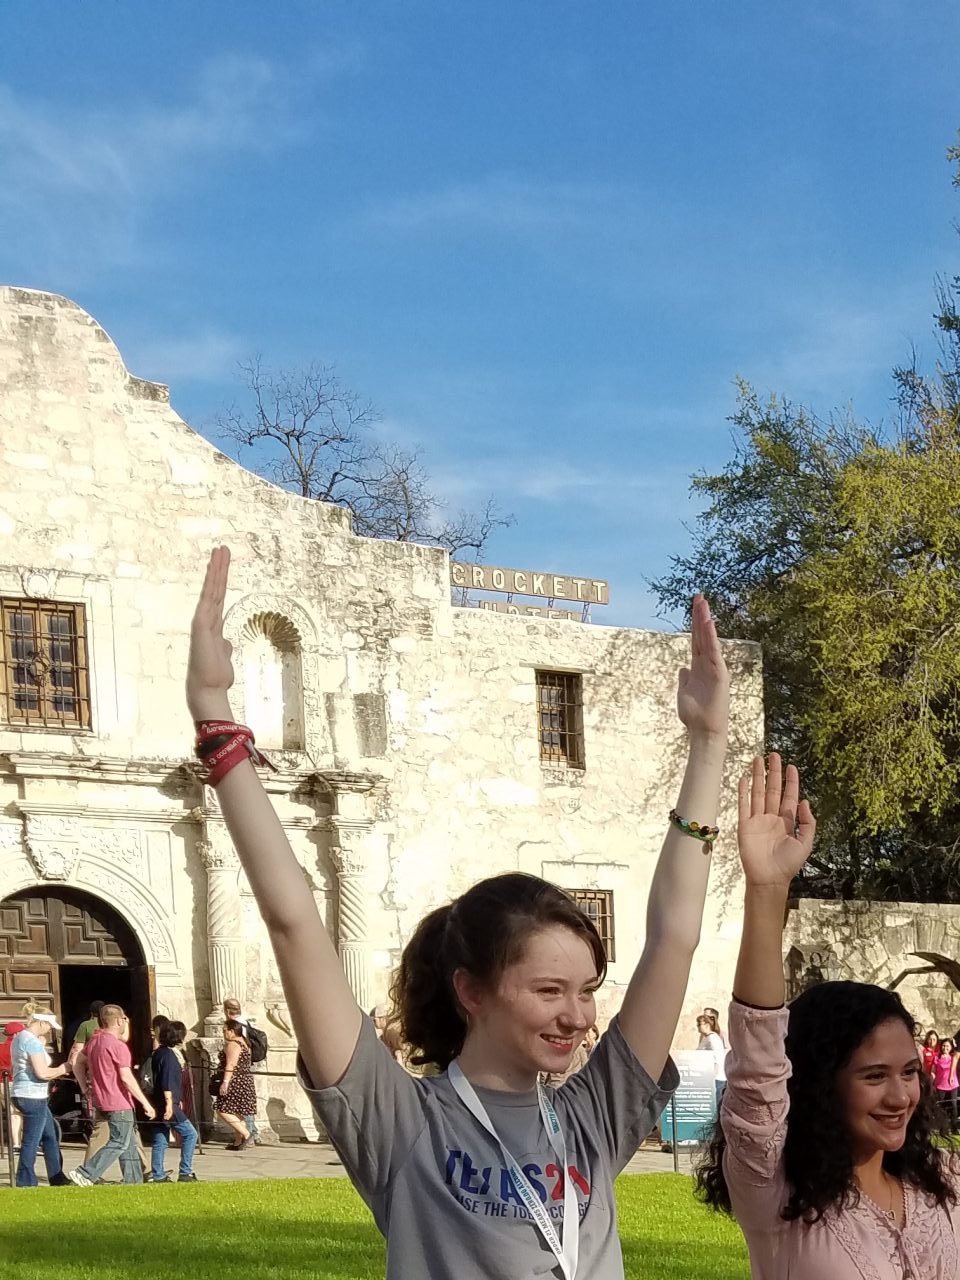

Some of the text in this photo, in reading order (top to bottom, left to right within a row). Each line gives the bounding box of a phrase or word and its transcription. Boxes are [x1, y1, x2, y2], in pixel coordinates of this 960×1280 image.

[452, 564, 606, 602] CROCKETT
[484, 1201, 508, 1217] THE
[534, 1209, 549, 1230] MEANS
